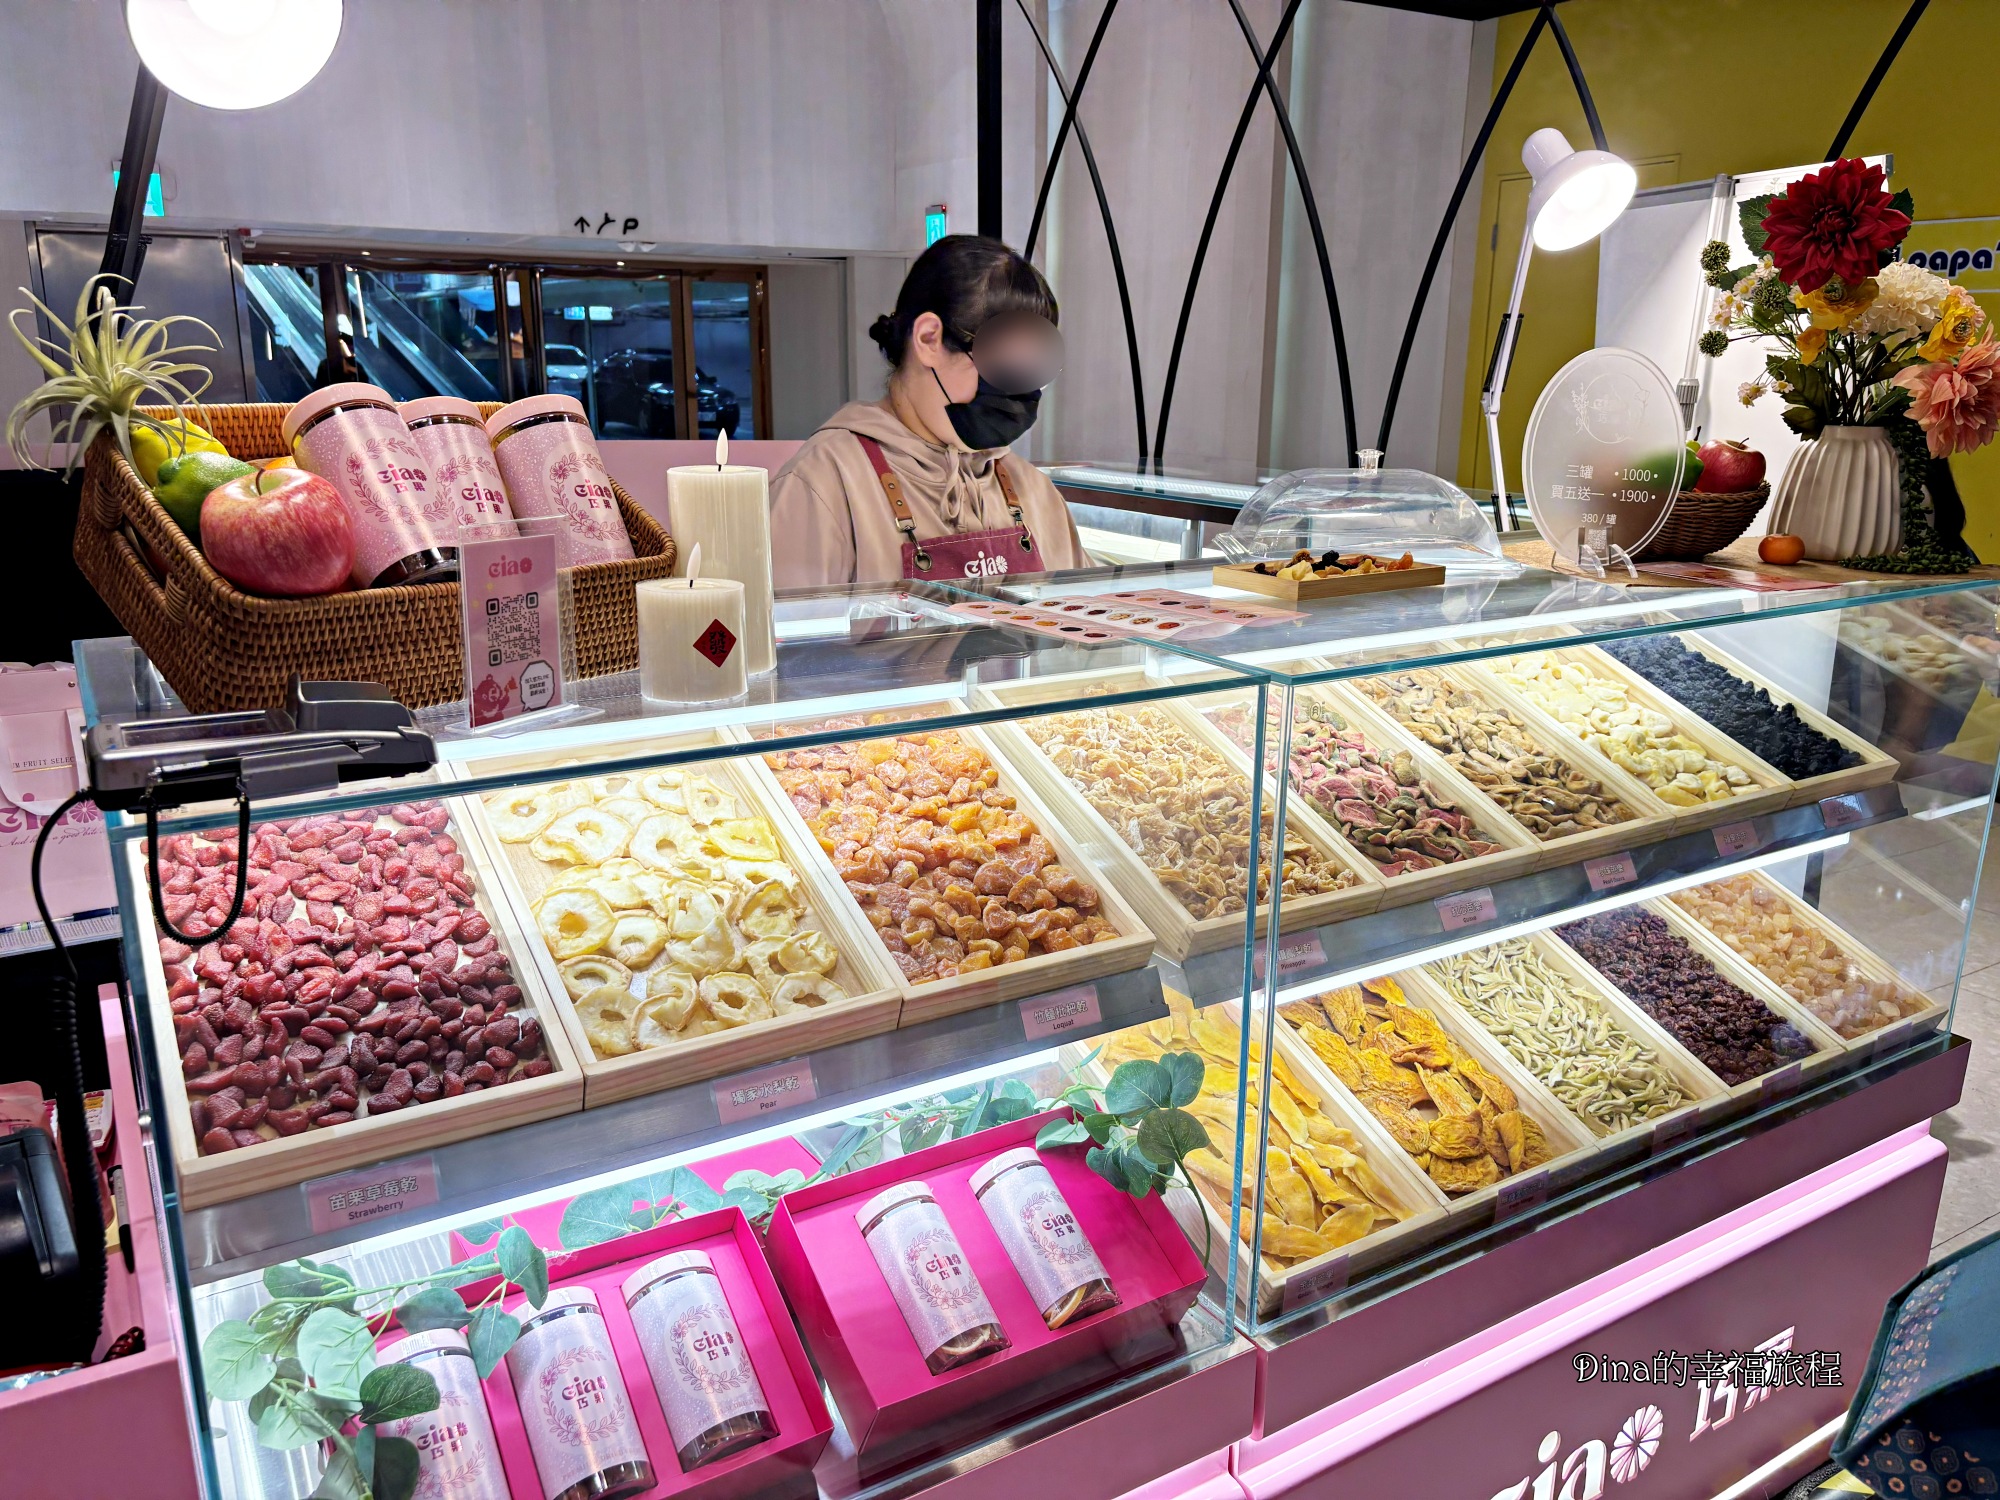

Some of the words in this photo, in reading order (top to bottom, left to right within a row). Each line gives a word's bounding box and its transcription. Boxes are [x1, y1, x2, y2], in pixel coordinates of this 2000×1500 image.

[622, 217, 639, 235] P
[1566, 464, 1594, 480] 三罐
[1622, 468, 1651, 482] 1000
[1550, 484, 1605, 501] 買五送一
[1619, 489, 1649, 503] 1900
[1581, 513, 1599, 524] 380
[1606, 514, 1617, 525] 罐
[504, 623, 523, 635] LINE
[1052, 1018, 1075, 1030] Loquat
[731, 1075, 800, 1107] 獨家水梨乾
[760, 1100, 777, 1111] Pear
[328, 1175, 419, 1212] 苗栗草莓乾
[348, 1200, 404, 1221] Strawberry
